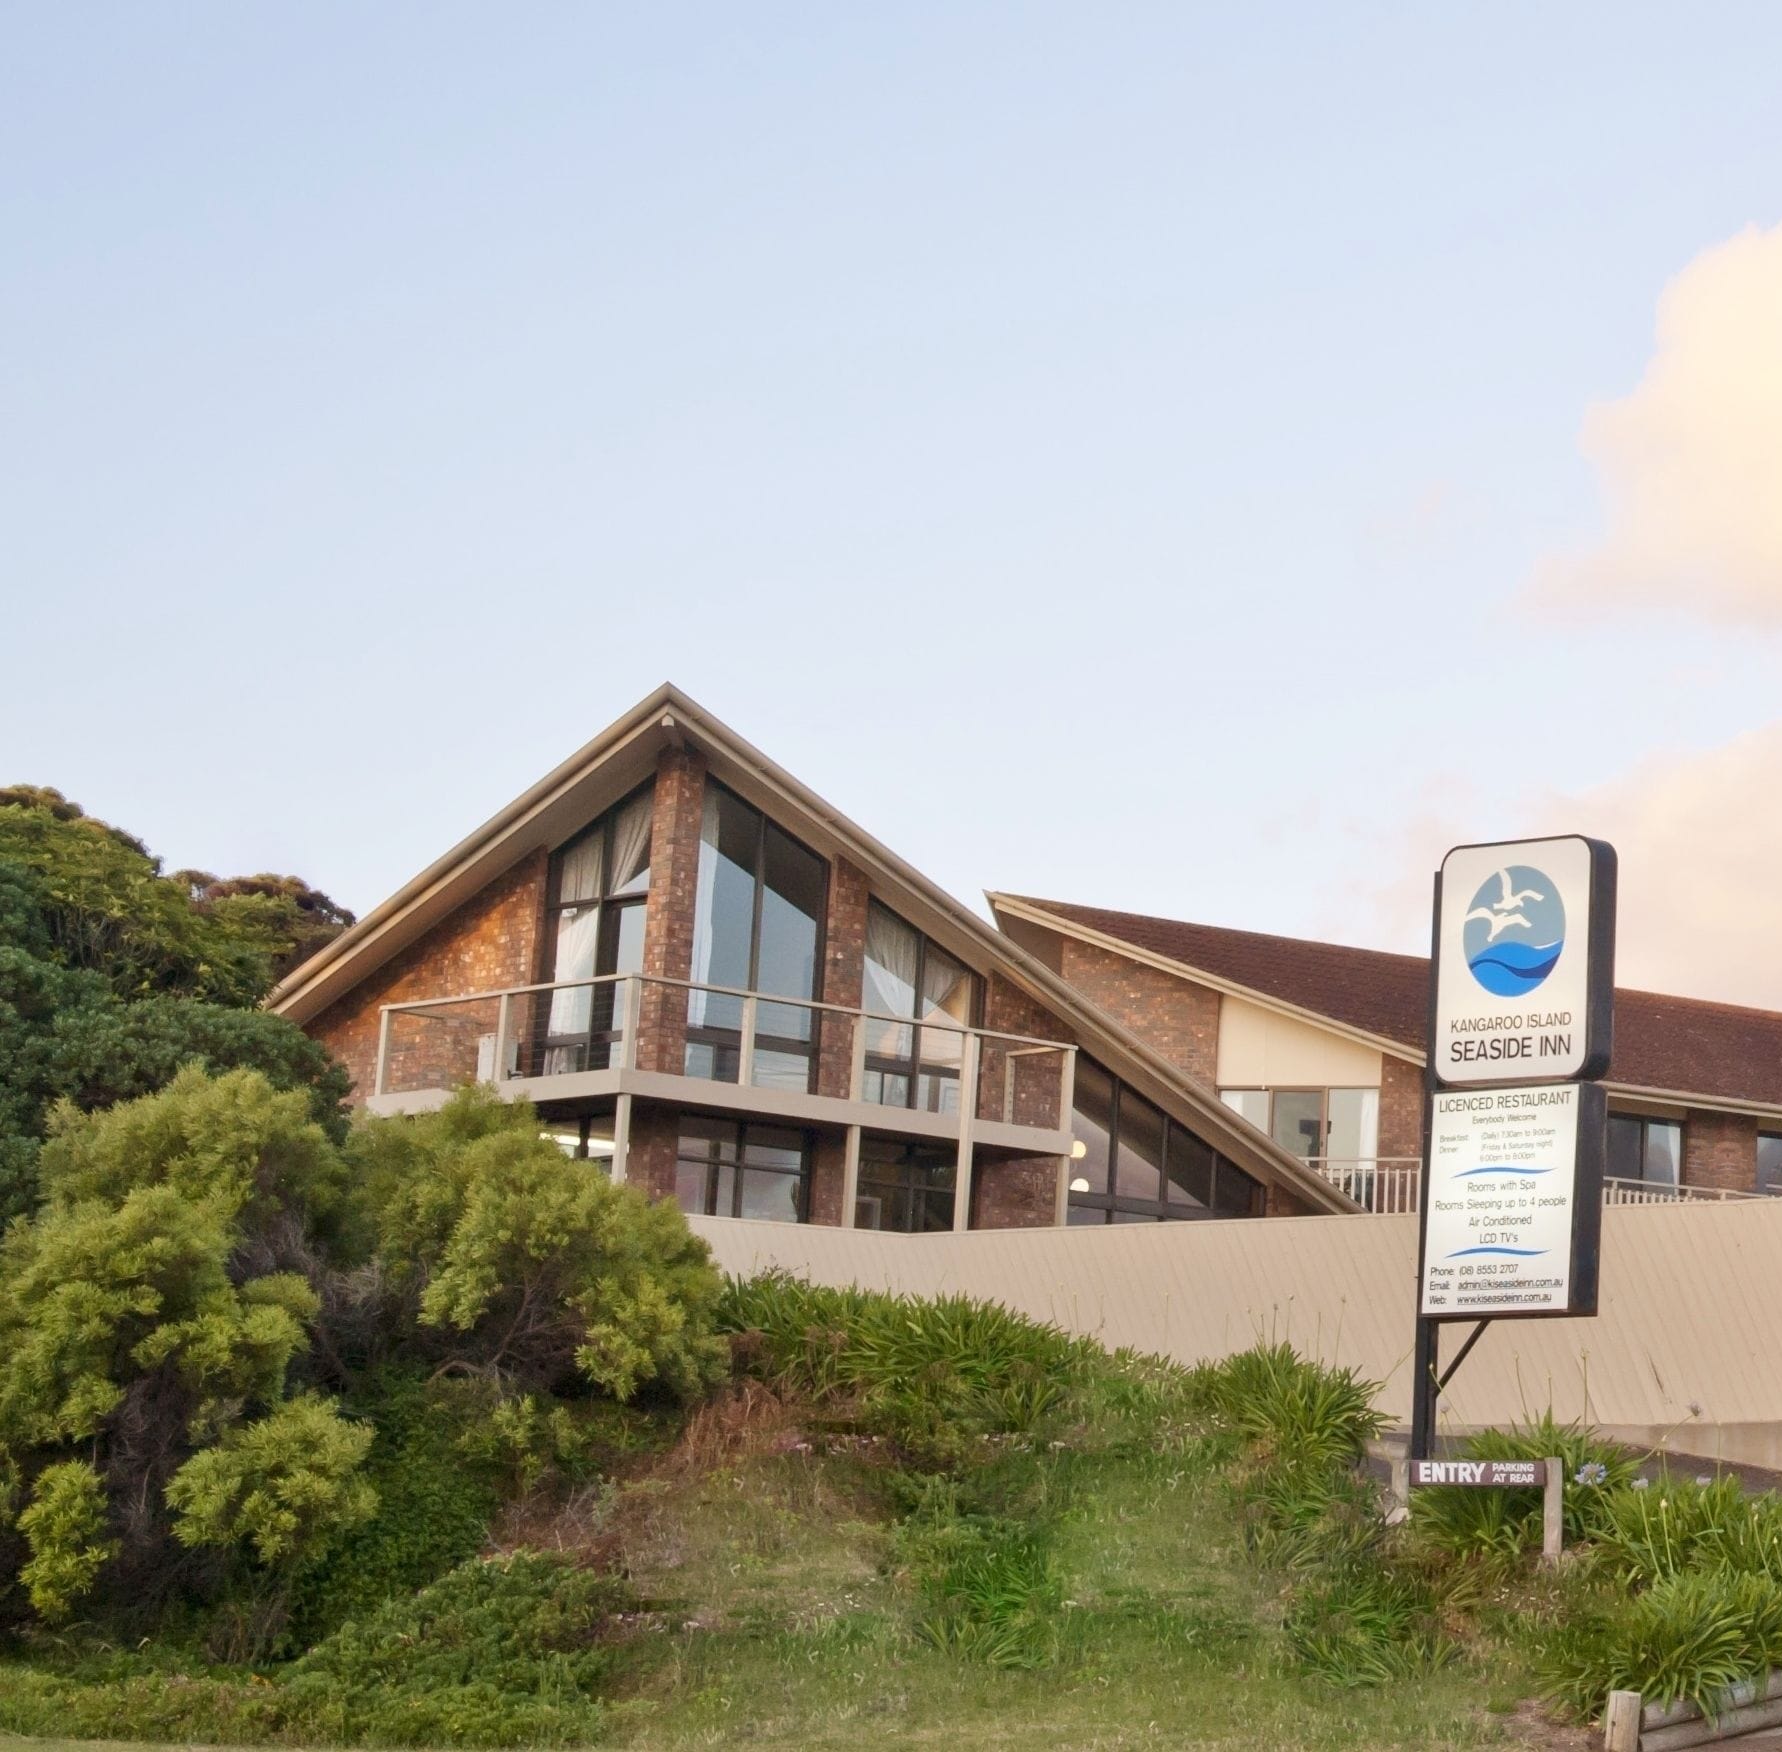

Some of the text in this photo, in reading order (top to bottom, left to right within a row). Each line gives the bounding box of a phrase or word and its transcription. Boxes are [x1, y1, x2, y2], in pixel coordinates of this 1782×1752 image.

[1451, 1012, 1572, 1033] KANGAROO ISLAND
[1451, 1034, 1571, 1062] SEASIDE INN
[1439, 1091, 1572, 1113] LICENCED RESTAURANT
[1472, 1113, 1537, 1125] Everybody Welcome
[1467, 1179, 1536, 1192] Rooms with Spa
[1435, 1196, 1567, 1211] Rooms Sleeping up to 4 people
[1468, 1215, 1532, 1227] Air Conditioned
[1480, 1232, 1518, 1244] LCD TV's
[1459, 1265, 1474, 1276] (08)
[1500, 1263, 1519, 1273] 2707
[1419, 1462, 1486, 1483] ENTRY
[1491, 1462, 1535, 1473] PARKING
[1491, 1473, 1535, 1483] AT REAR
